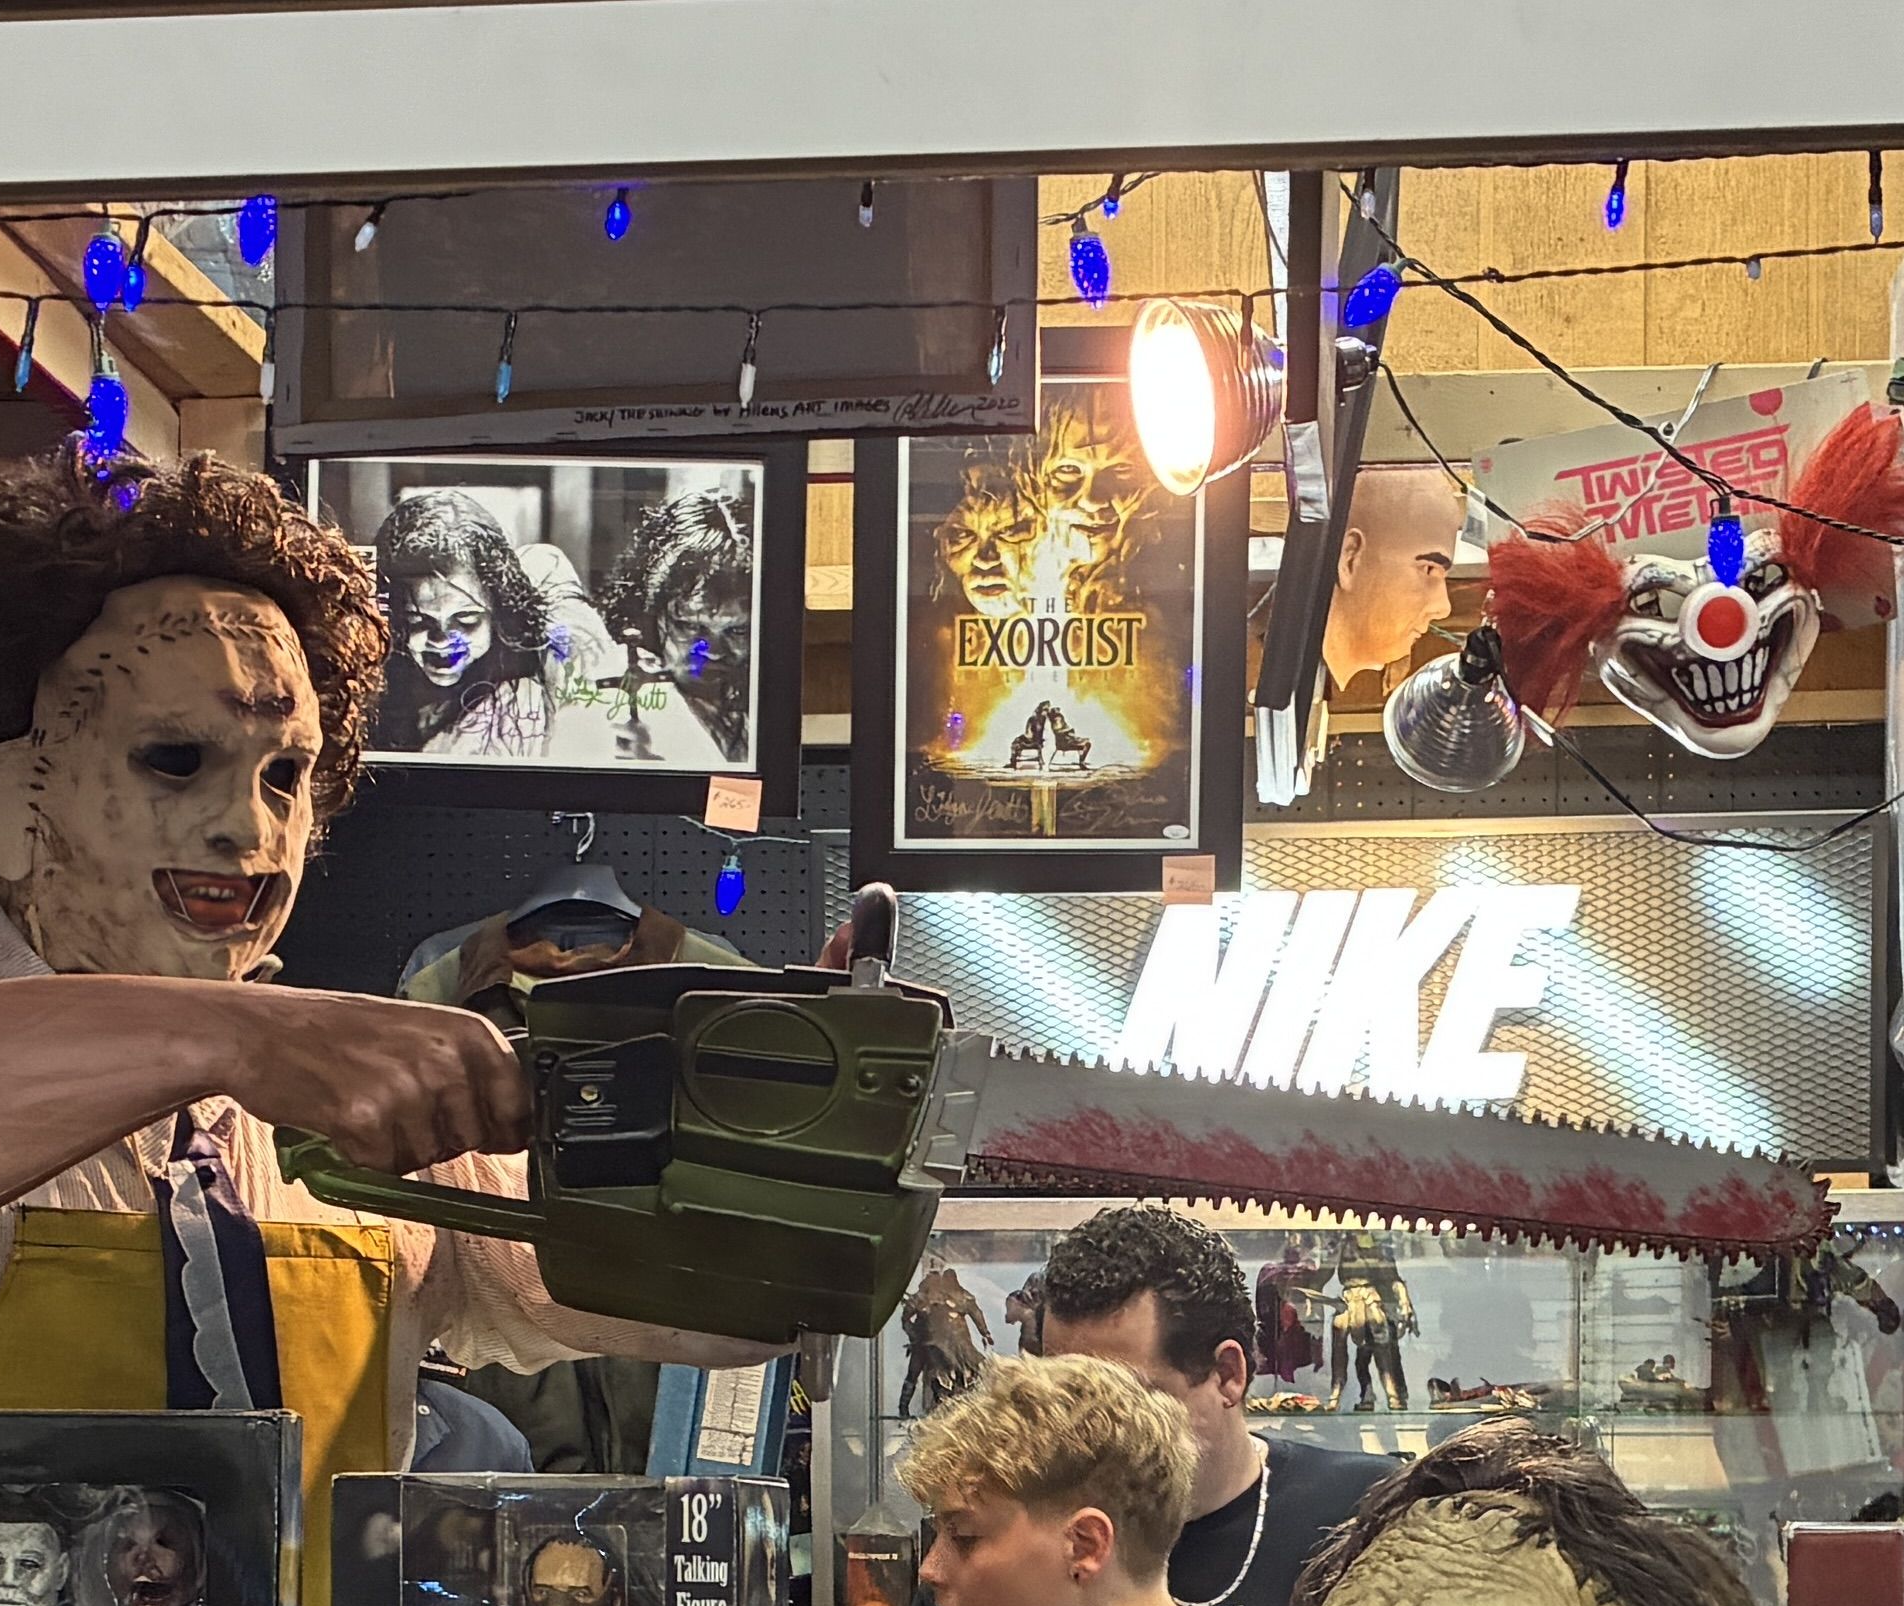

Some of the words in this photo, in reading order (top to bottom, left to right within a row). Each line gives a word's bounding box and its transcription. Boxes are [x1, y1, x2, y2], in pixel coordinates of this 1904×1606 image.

[1028, 597, 1072, 614] THE
[958, 617, 1142, 667] EXORCIST
[1118, 885, 1581, 1100] NIKE
[674, 1555, 729, 1588] Talking
